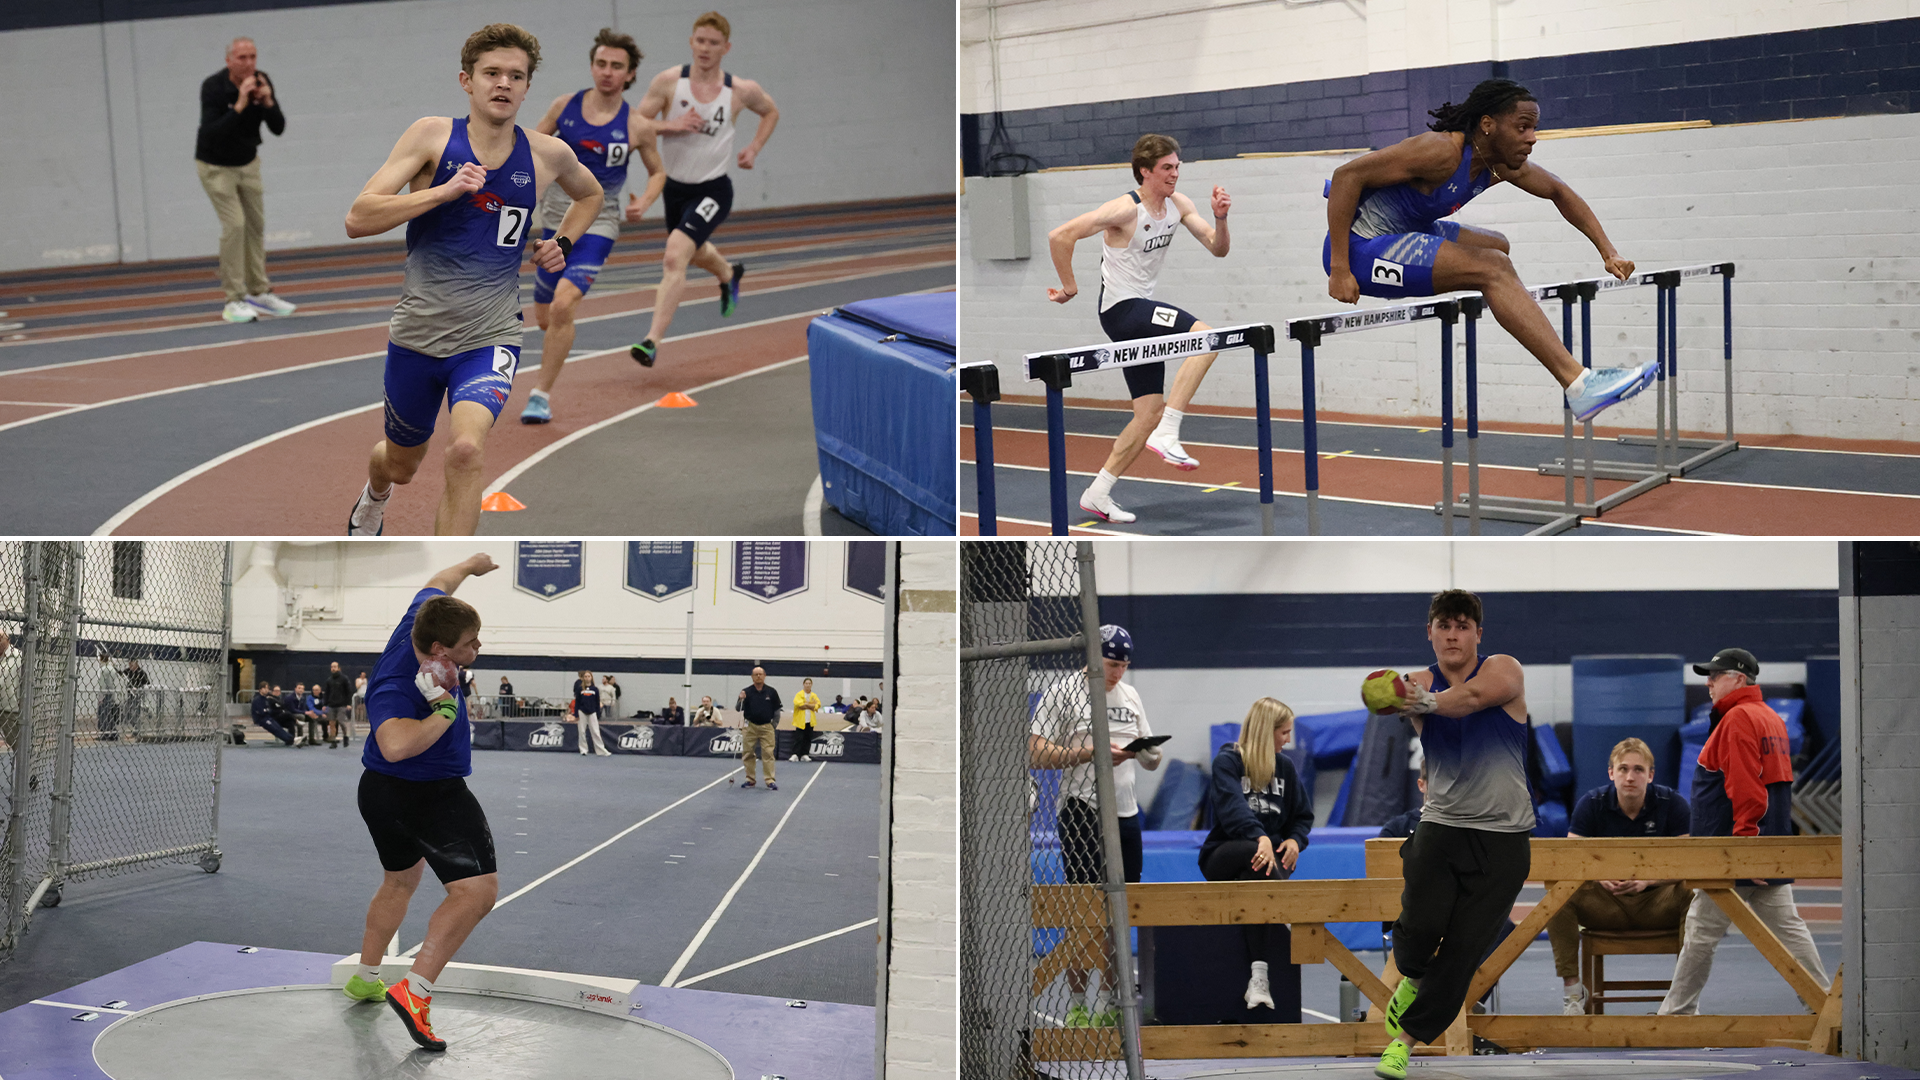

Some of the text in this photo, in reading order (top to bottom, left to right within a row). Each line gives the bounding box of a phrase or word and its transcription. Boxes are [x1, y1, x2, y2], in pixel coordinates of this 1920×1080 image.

[713, 106, 725, 126] 4
[611, 145, 623, 165] 9
[702, 202, 716, 217] 4
[502, 209, 522, 245] 2
[1374, 265, 1402, 283] 3
[1156, 311, 1175, 323] 4
[1344, 316, 1362, 329] NEW
[1363, 309, 1406, 327] HAMPSHIRE
[1113, 347, 1139, 364] NEW
[1142, 337, 1203, 360] HAMPSHIRE
[1226, 332, 1245, 345] GILL
[498, 349, 513, 380] 2
[531, 734, 564, 746] UNH
[620, 738, 653, 749] UNH
[809, 743, 843, 755] UNH
